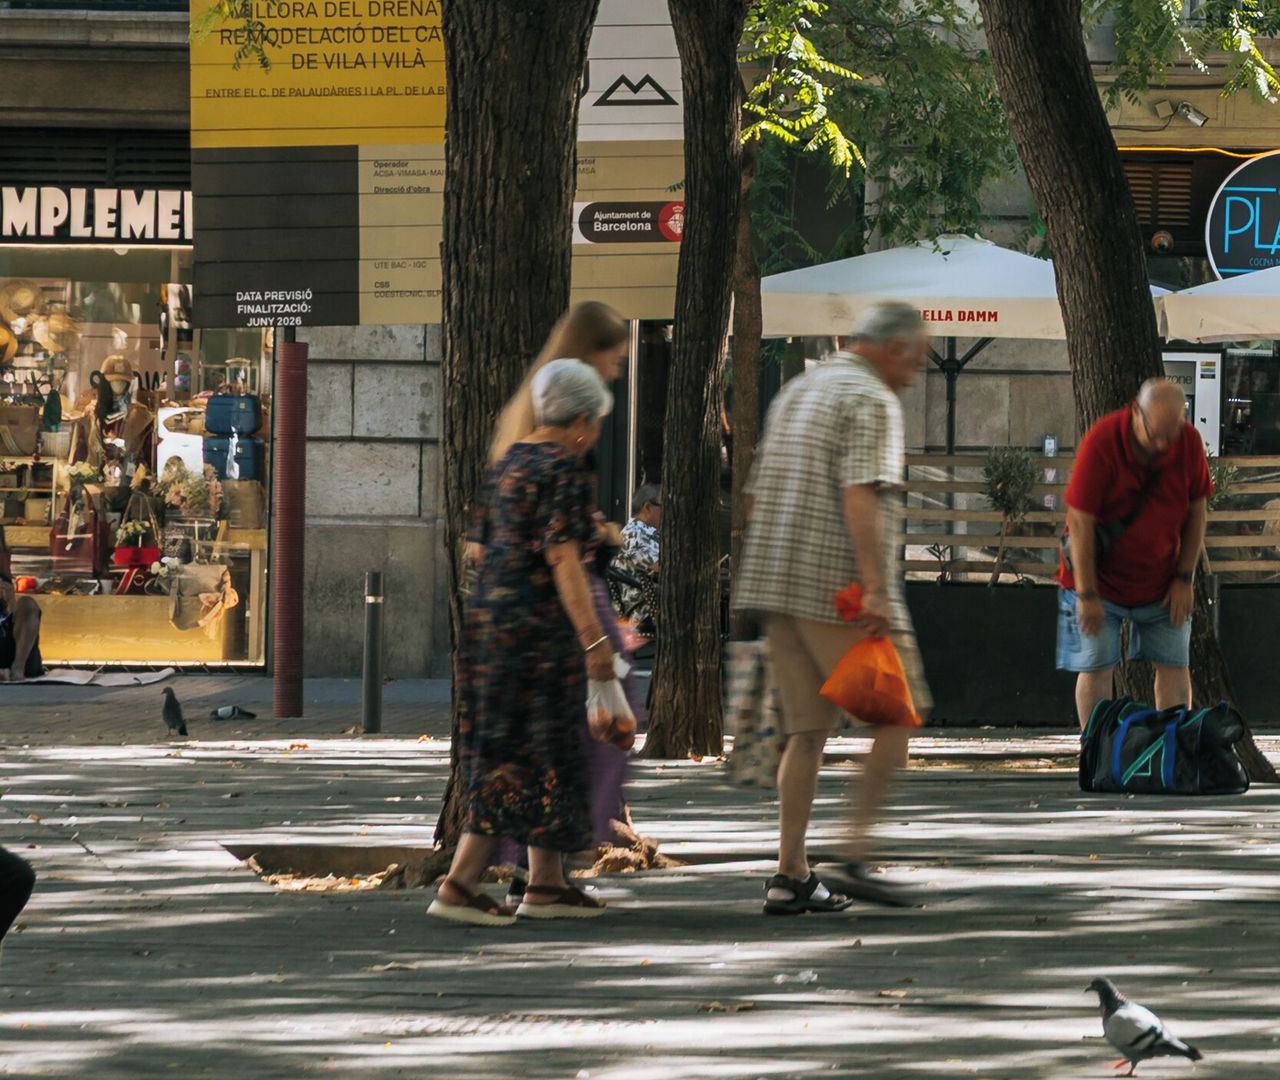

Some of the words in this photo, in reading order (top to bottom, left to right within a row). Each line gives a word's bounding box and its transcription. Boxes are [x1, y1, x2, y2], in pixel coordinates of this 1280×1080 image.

[324, 1, 363, 18] DEL
[220, 23, 366, 45] REMODELACIÓ
[372, 26, 411, 43] DEL
[292, 53, 318, 69] DE
[323, 52, 366, 69] VILA
[372, 52, 376, 69] I
[382, 48, 426, 69] VILÀ
[206, 88, 241, 98] ENTRE
[244, 88, 257, 98] EL
[259, 88, 269, 97] C.
[272, 88, 286, 97] DE
[289, 85, 362, 97] PALAUDÀRIES
[371, 87, 383, 96] LA
[386, 87, 402, 96] PL.
[405, 86, 419, 96] DE
[422, 86, 436, 95] LA
[438, 86, 447, 95] B
[2, 187, 192, 239] MPLEME
[593, 210, 640, 221] Ajuntament
[641, 211, 652, 219] de
[593, 221, 652, 231] Barcelona
[236, 291, 262, 301] DATA
[264, 288, 313, 301] PREVISIÓ
[237, 301, 312, 314] FINALITZACIÓ:
[246, 316, 275, 327] JUNY
[957, 310, 999, 322] DAMM
